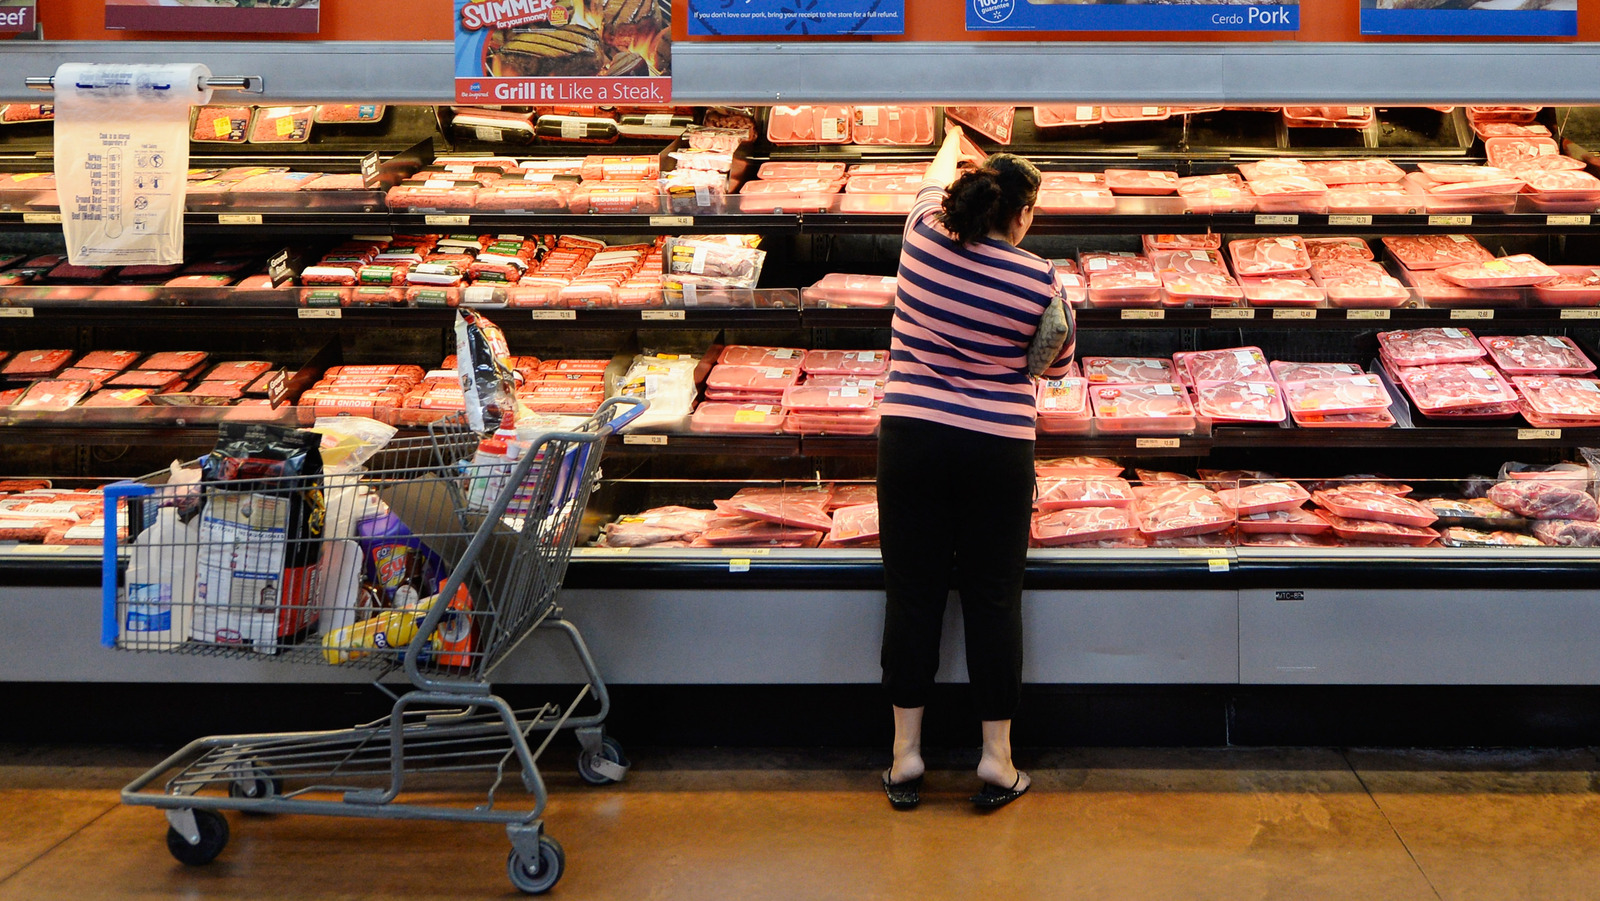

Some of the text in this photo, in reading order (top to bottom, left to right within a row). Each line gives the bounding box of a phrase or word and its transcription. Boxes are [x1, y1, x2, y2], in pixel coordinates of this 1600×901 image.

[464, 0, 554, 27] SUMMER
[981, 2, 1010, 14] guarantee
[1212, 6, 1290, 24] Cerdo Pork
[496, 20, 506, 28] for
[505, 18, 523, 28] your
[495, 82, 664, 99] Grill it Like a Steak.
